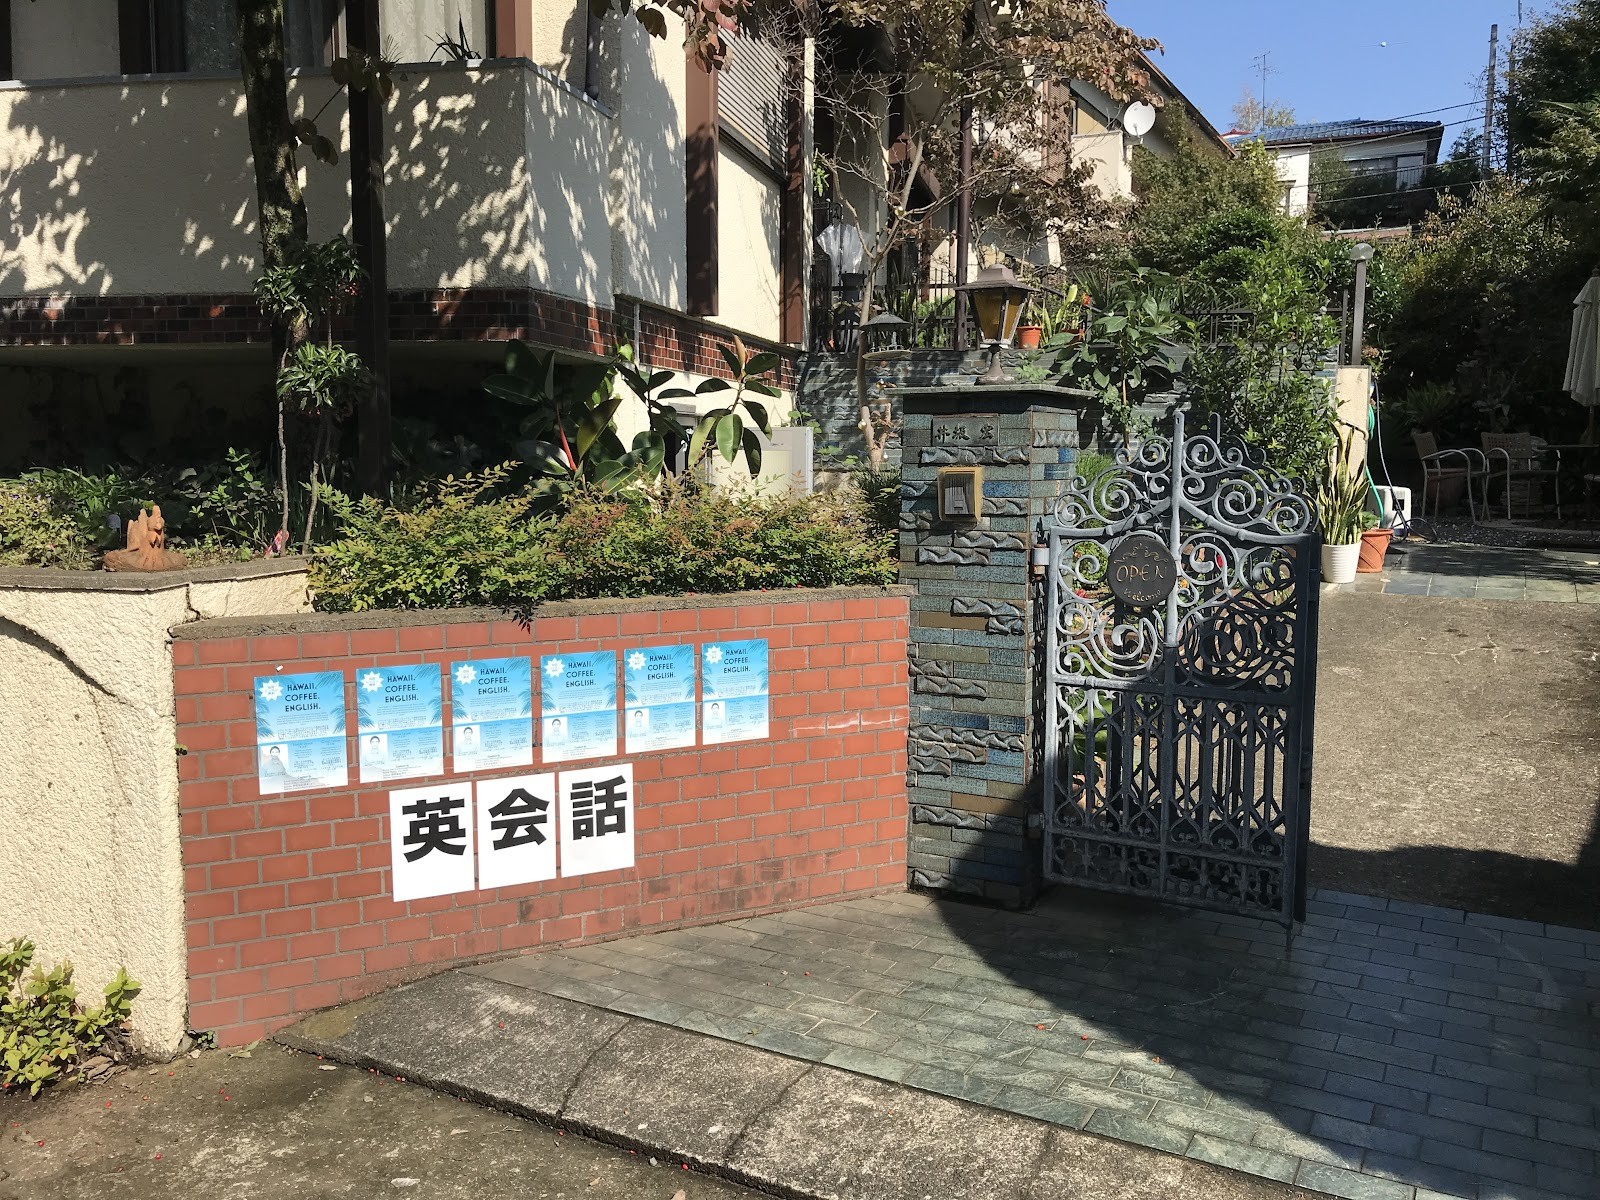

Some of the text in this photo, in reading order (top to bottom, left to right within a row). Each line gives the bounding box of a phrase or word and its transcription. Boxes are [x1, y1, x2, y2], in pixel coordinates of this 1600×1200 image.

[1116, 564, 1167, 582] OPEN
[649, 654, 674, 662] HAWAII.
[723, 657, 750, 665] COFFEE.
[568, 661, 594, 669] HAWAII.
[647, 663, 675, 671] COFFEE.
[723, 665, 751, 674] ENGLISH.
[480, 667, 507, 675] HAWAII.
[566, 670, 596, 679] COFFEE.
[387, 674, 416, 682] HAWAII.
[647, 672, 676, 680] ENGLISH.
[478, 677, 510, 686] COFFEE.
[566, 679, 596, 688] ENGLISH.
[287, 683, 317, 691] HAWAII.
[385, 684, 418, 693] COFFEE.
[478, 686, 510, 695] ENGLISH.
[285, 692, 320, 702] COFFEE.
[385, 693, 419, 703] ENGLISH.
[285, 703, 321, 712] ENGLISH.
[402, 775, 627, 863] 英会話
